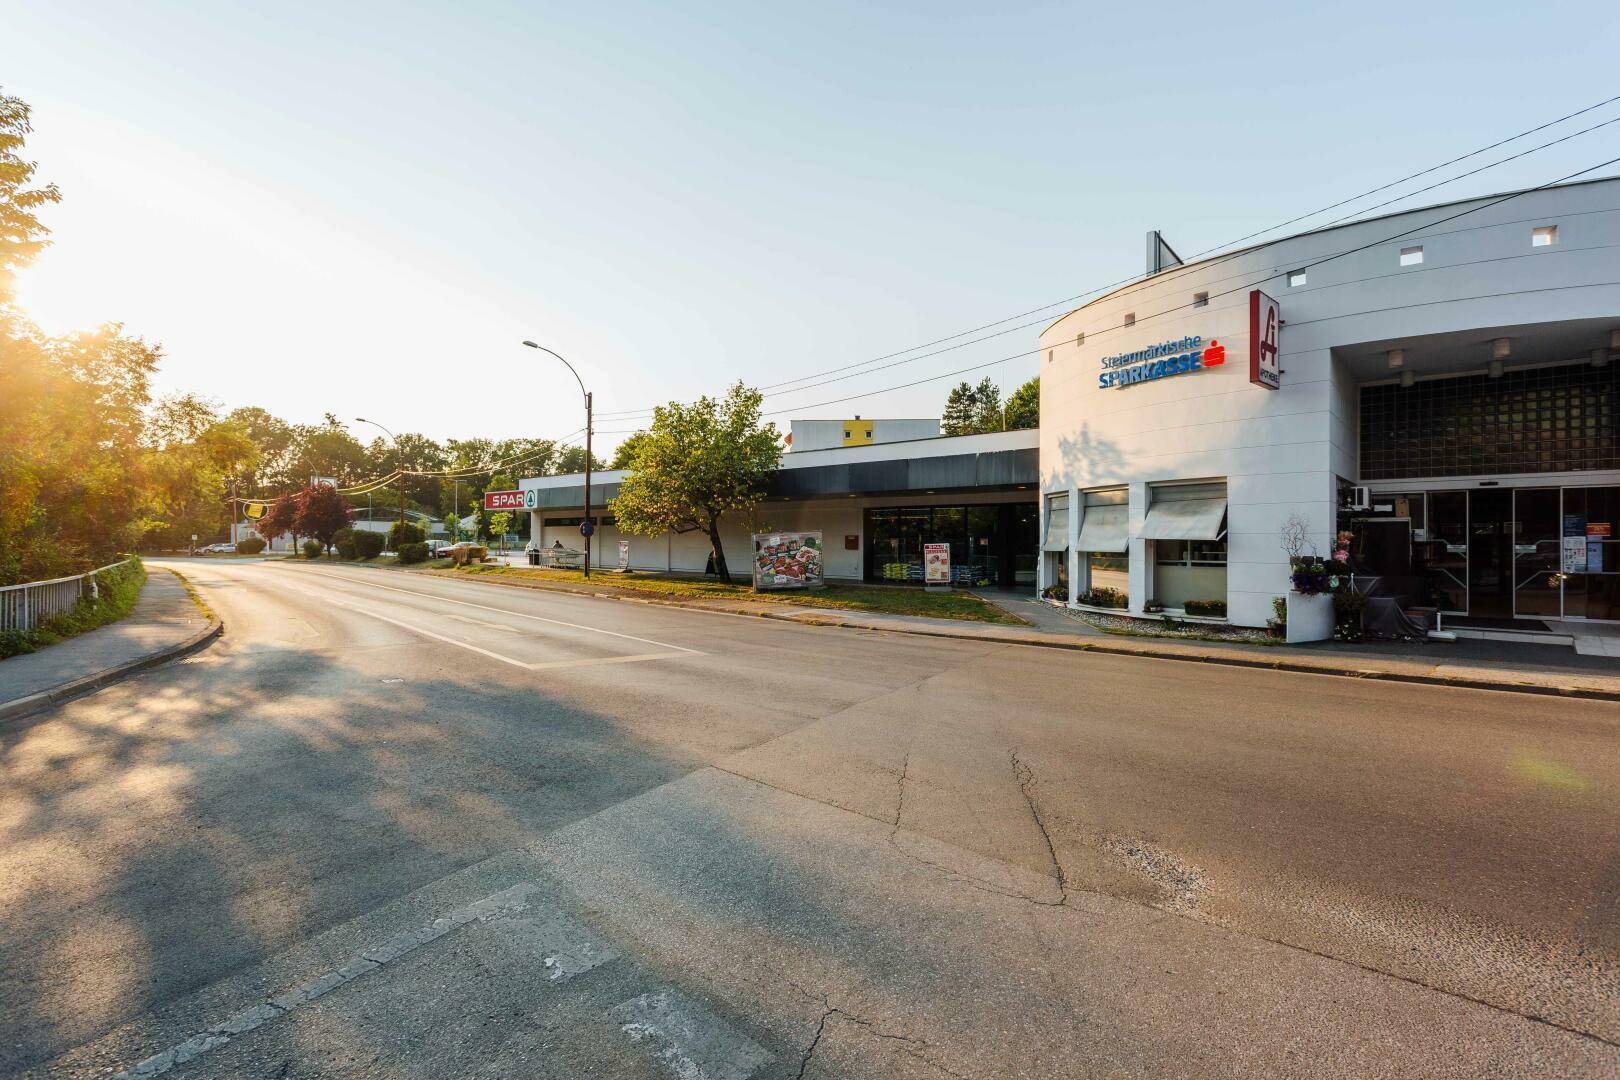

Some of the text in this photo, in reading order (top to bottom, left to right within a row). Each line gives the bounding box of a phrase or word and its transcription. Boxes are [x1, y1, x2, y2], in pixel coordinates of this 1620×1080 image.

[1099, 351, 1201, 389] SPARKASSE
[1101, 335, 1201, 370] Steiermärkische
[492, 494, 524, 506] SPAR
